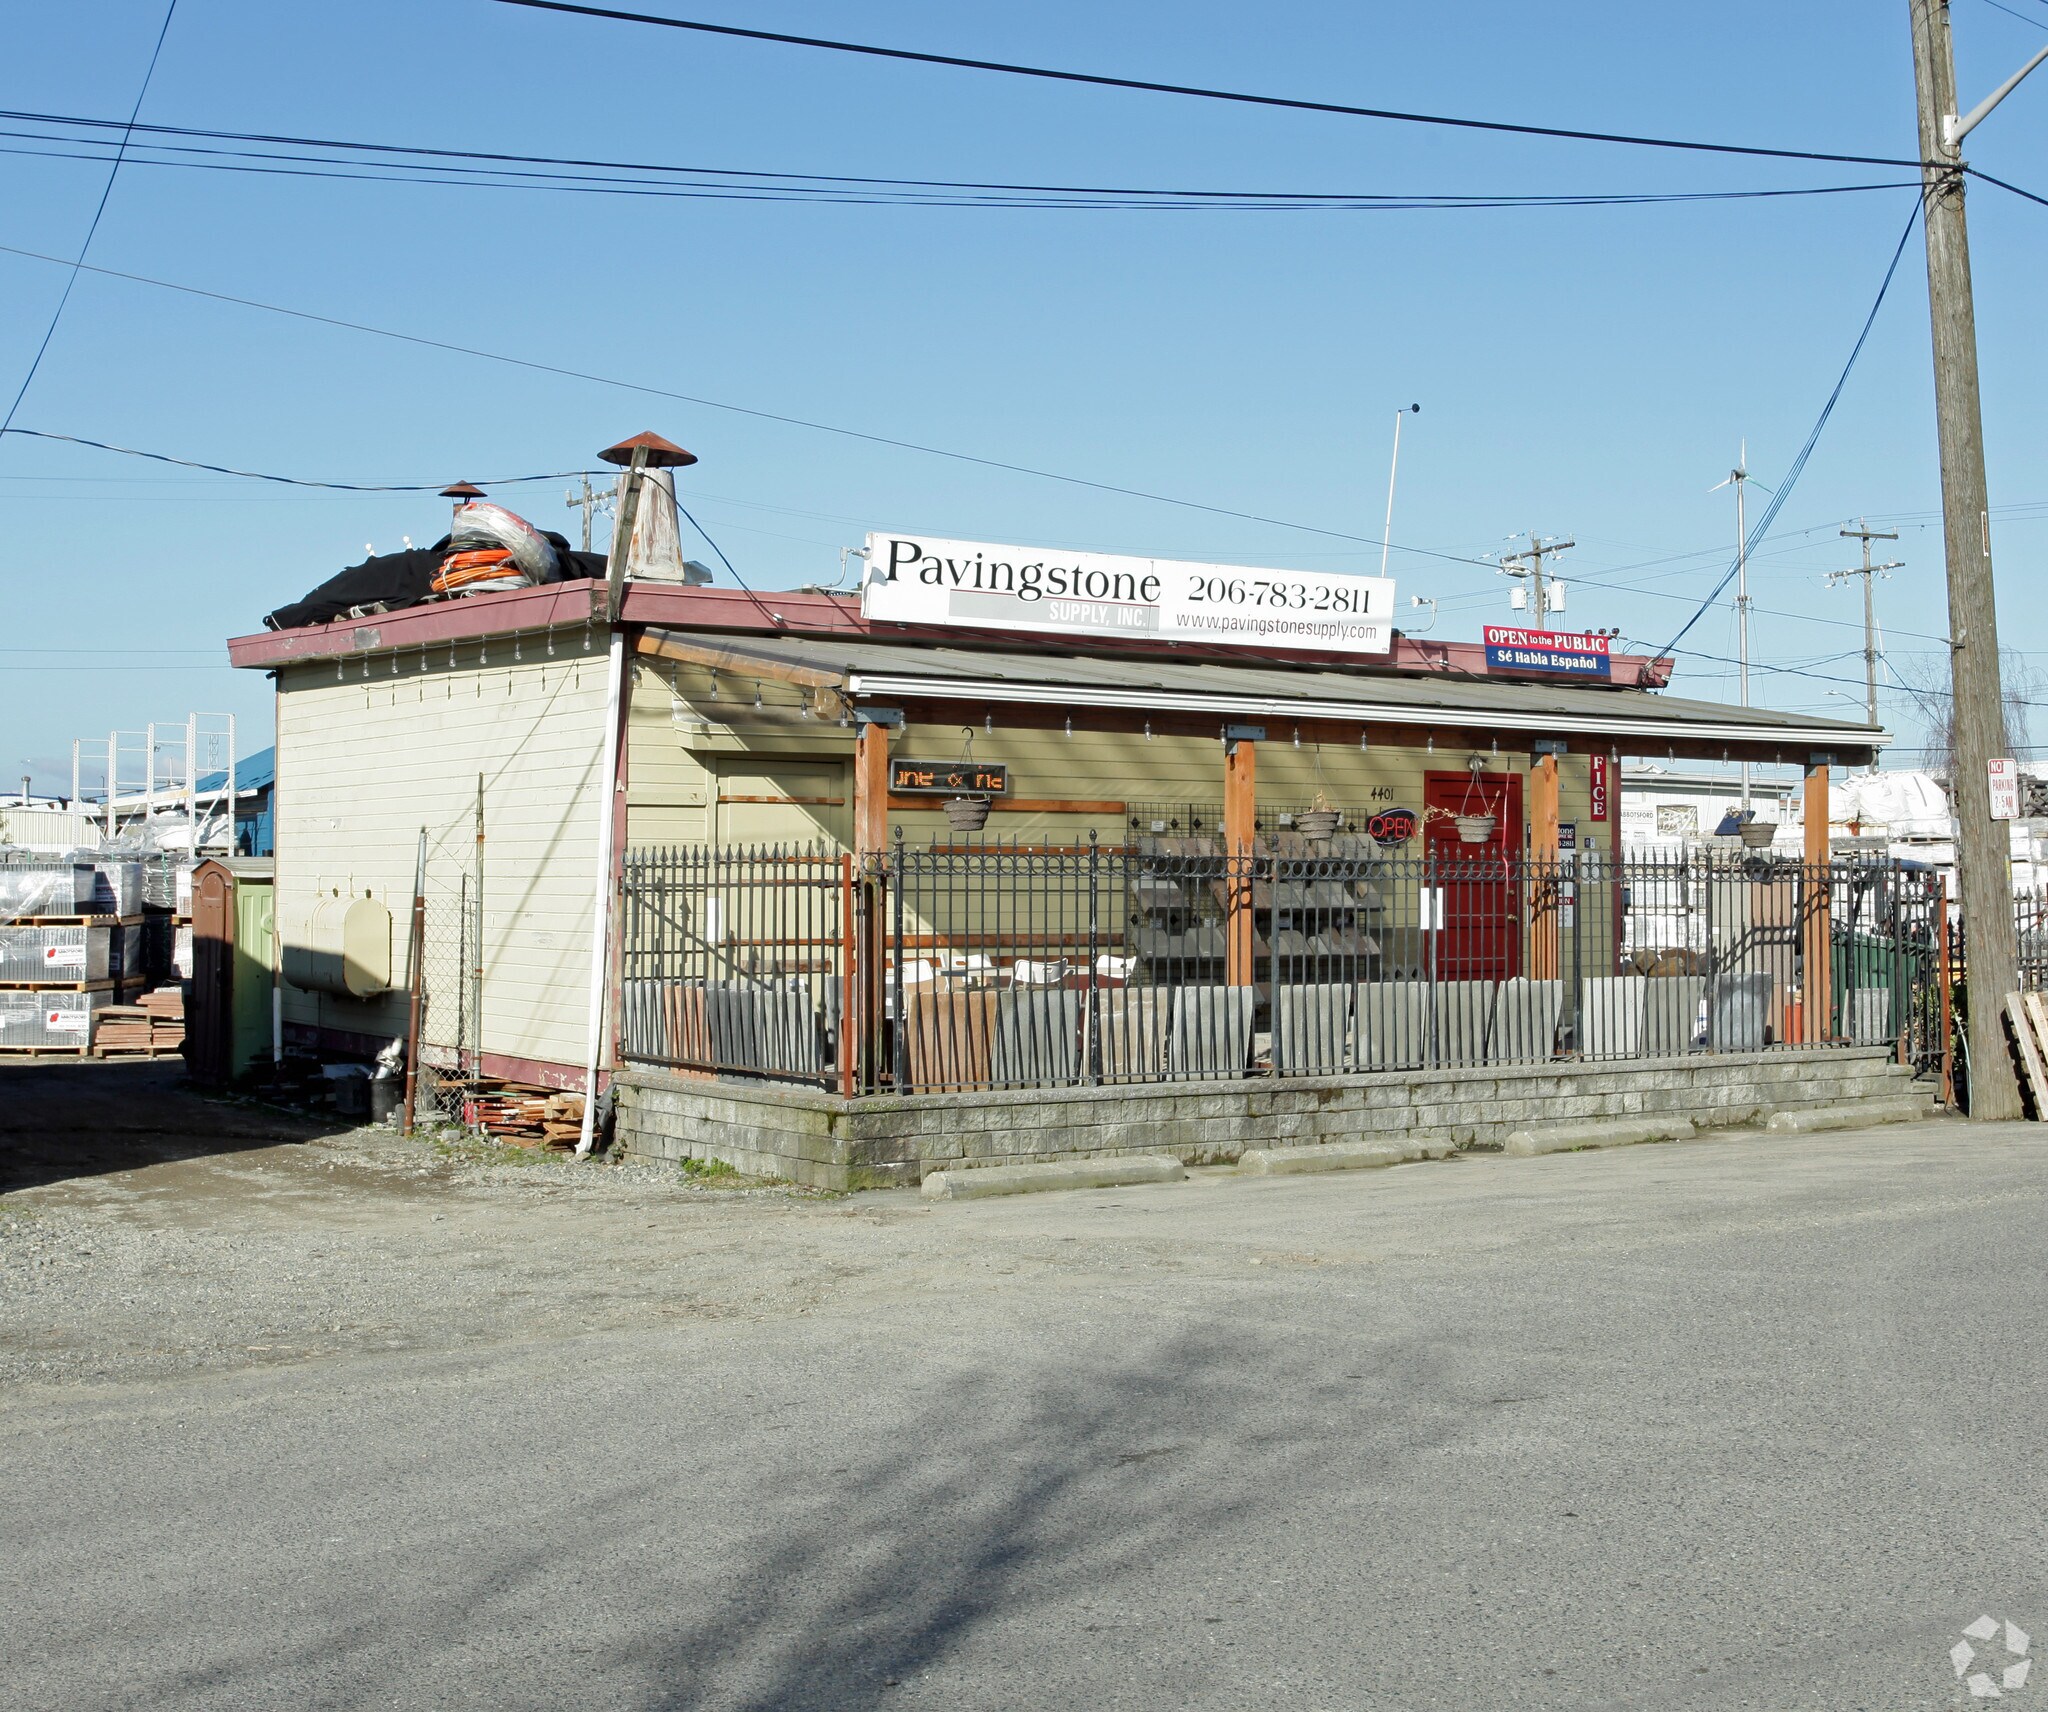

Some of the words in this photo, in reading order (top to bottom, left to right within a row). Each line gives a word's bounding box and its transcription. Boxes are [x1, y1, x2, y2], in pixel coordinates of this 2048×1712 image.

[885, 540, 1161, 602] Pavingstone
[1188, 575, 1370, 613] 206-783-2811
[1116, 608, 1147, 627] INC.
[1177, 612, 1377, 640] www.pavingstonesupply.com
[1488, 628, 1528, 646] OPEN
[1554, 634, 1605, 653] PUBLIC
[1497, 650, 1513, 663] Sé
[1515, 652, 1548, 666] Habla
[1551, 655, 1597, 670] Español
[1991, 761, 2002, 772] NO
[1371, 787, 1394, 800] 4401
[1993, 779, 2013, 791] PARKING
[1369, 816, 1419, 841] OPEN
